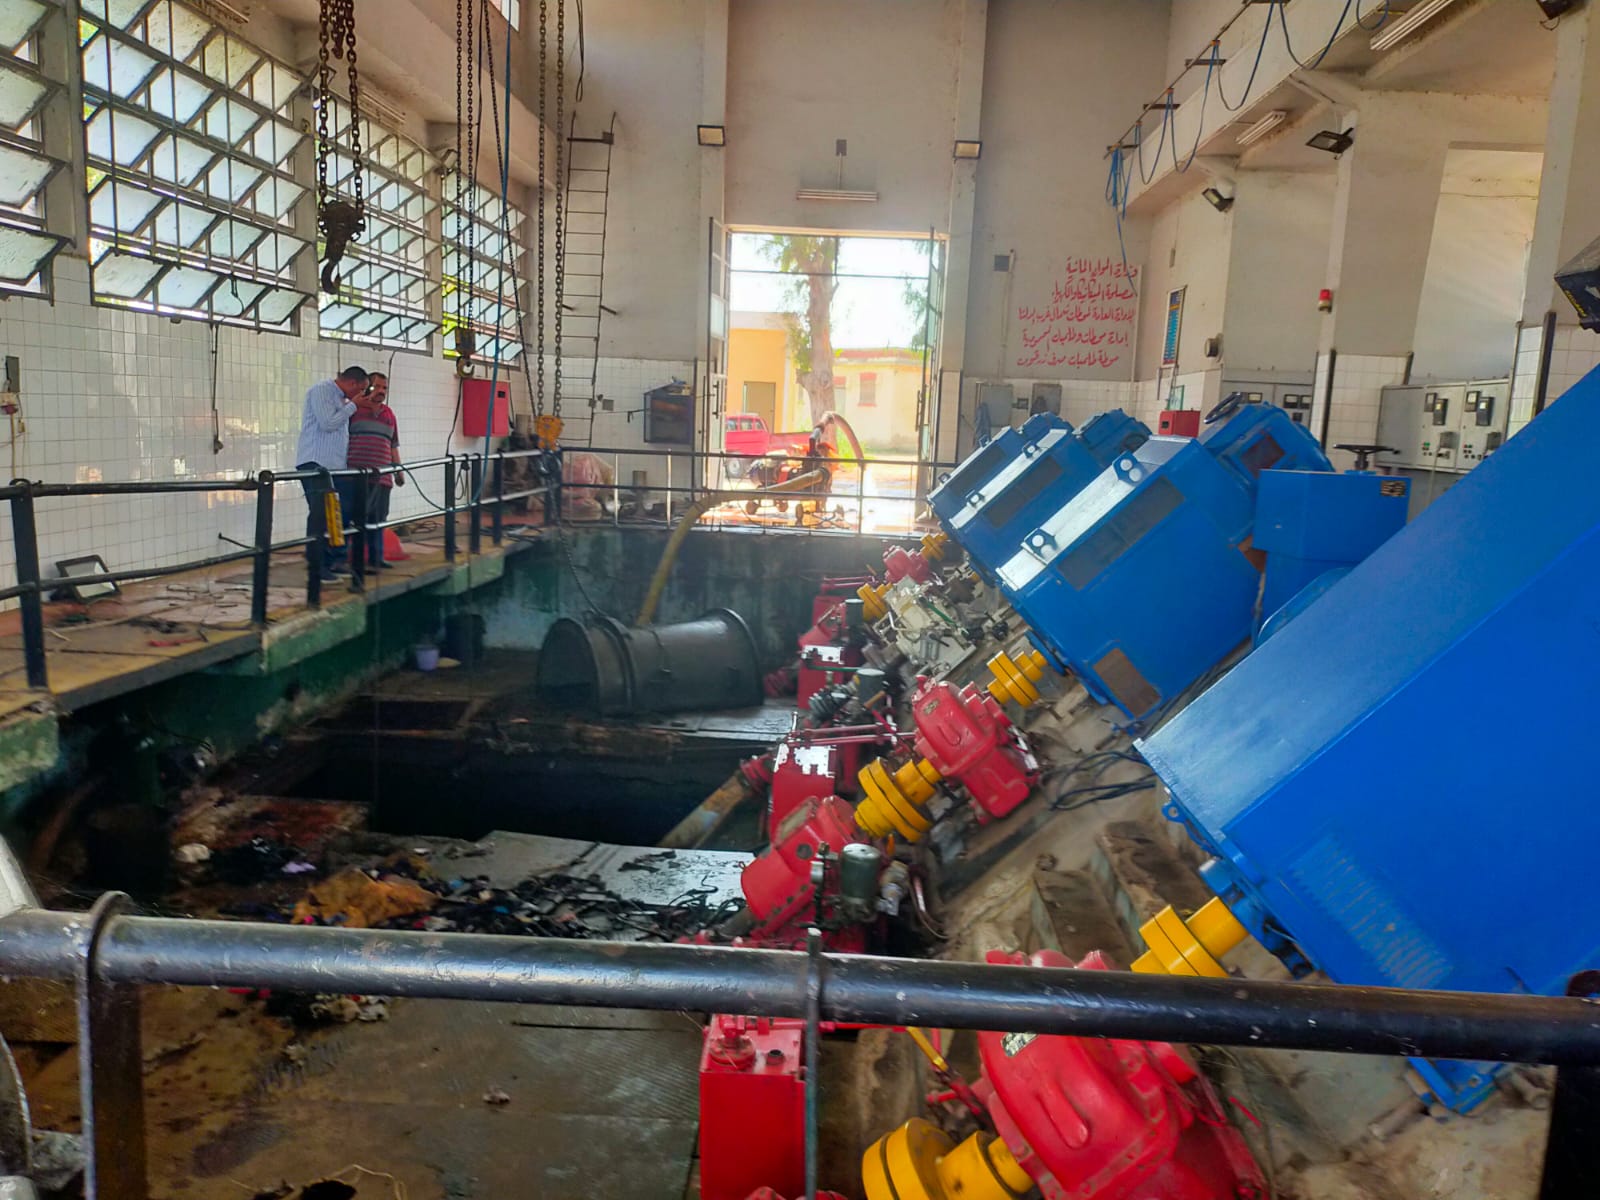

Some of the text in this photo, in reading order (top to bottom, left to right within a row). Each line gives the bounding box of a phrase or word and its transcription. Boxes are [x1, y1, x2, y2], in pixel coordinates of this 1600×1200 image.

[1092, 257, 1113, 278] الموارد
[1114, 262, 1138, 278] وزارة
[1104, 282, 1134, 300] مصلحة
[1050, 304, 1070, 322] شمال
[1092, 306, 1114, 321] العامة
[1081, 327, 1106, 345] محطات
[1046, 351, 1066, 366] صرف
[1068, 351, 1097, 369] طلمبات
[1098, 349, 1119, 368] محطة
